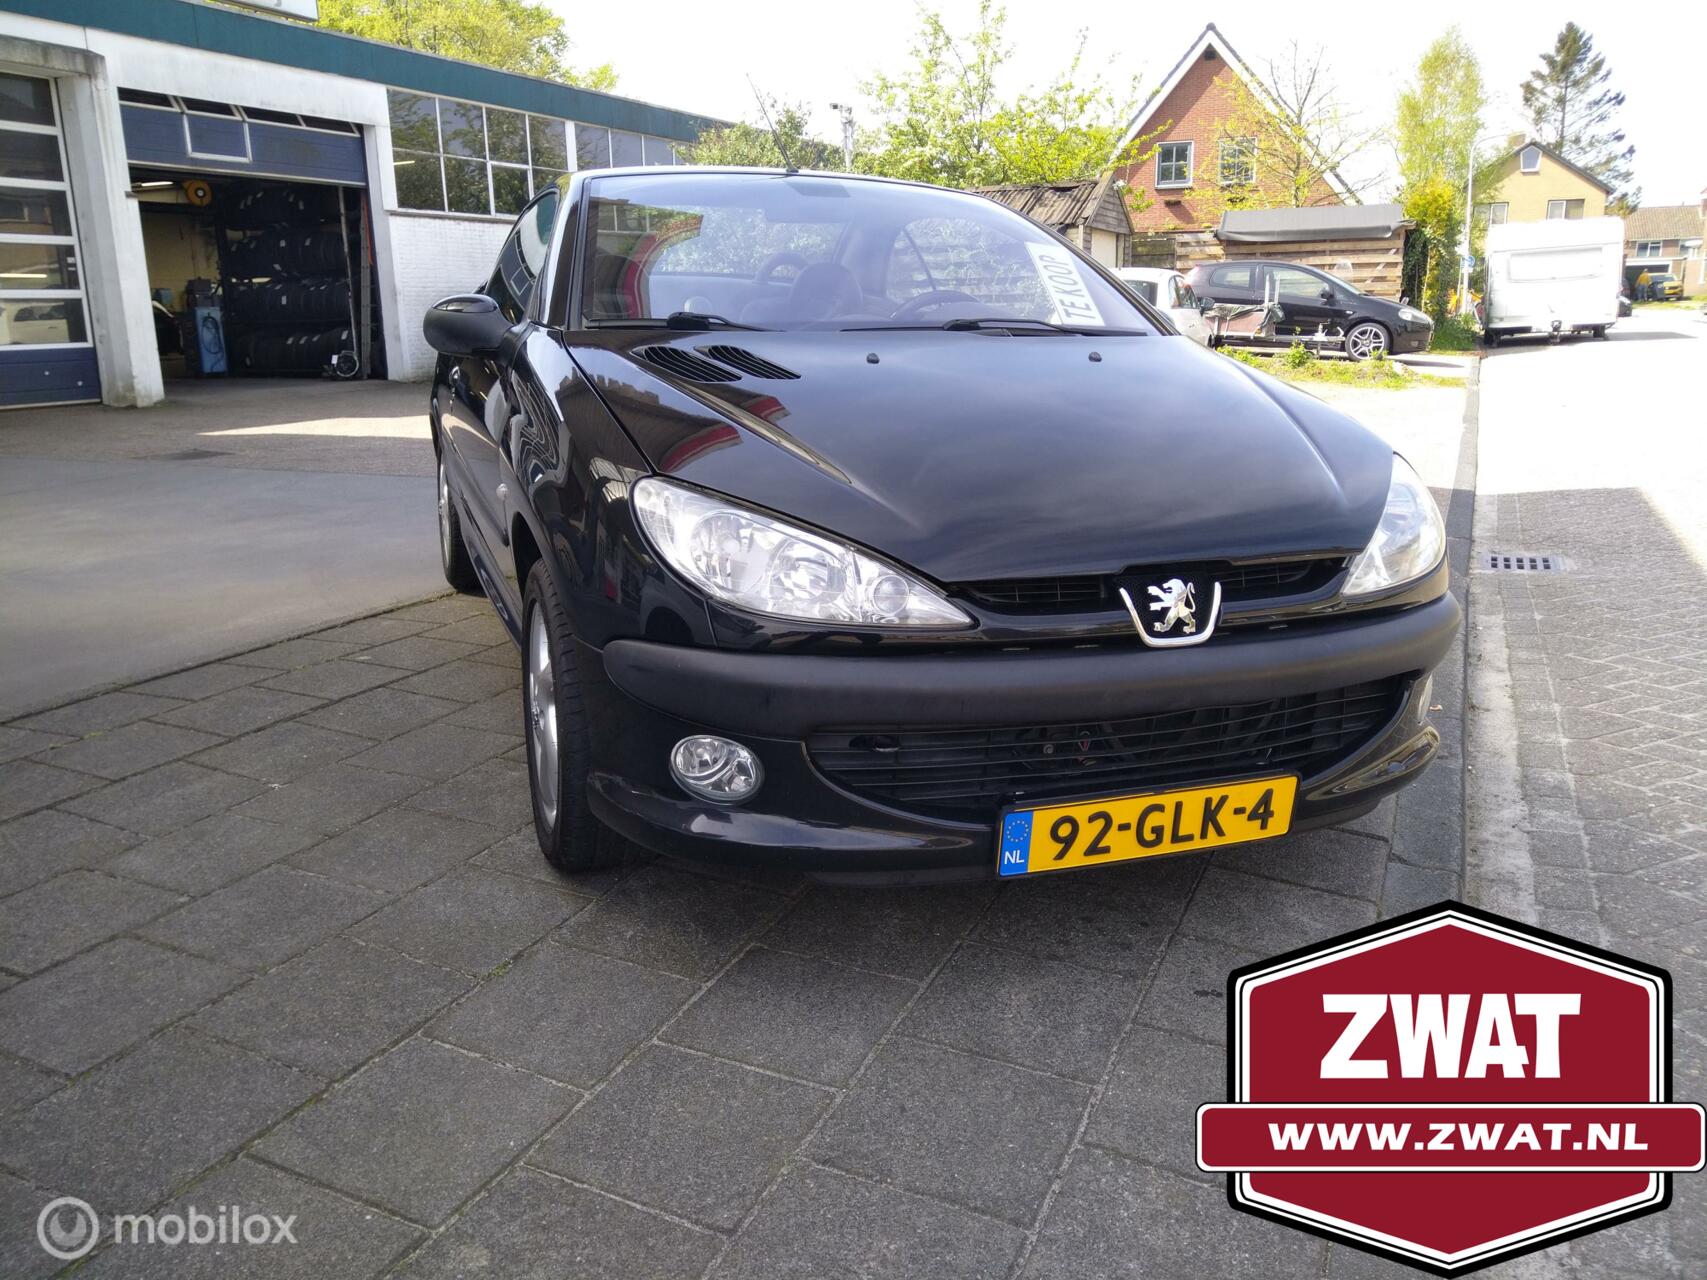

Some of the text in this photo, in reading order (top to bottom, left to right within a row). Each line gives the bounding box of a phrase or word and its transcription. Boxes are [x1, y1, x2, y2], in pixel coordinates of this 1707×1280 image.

[1038, 254, 1096, 319] TE KOOP
[1003, 849, 1025, 865] NL
[1049, 788, 1275, 861] 92-GLK-4
